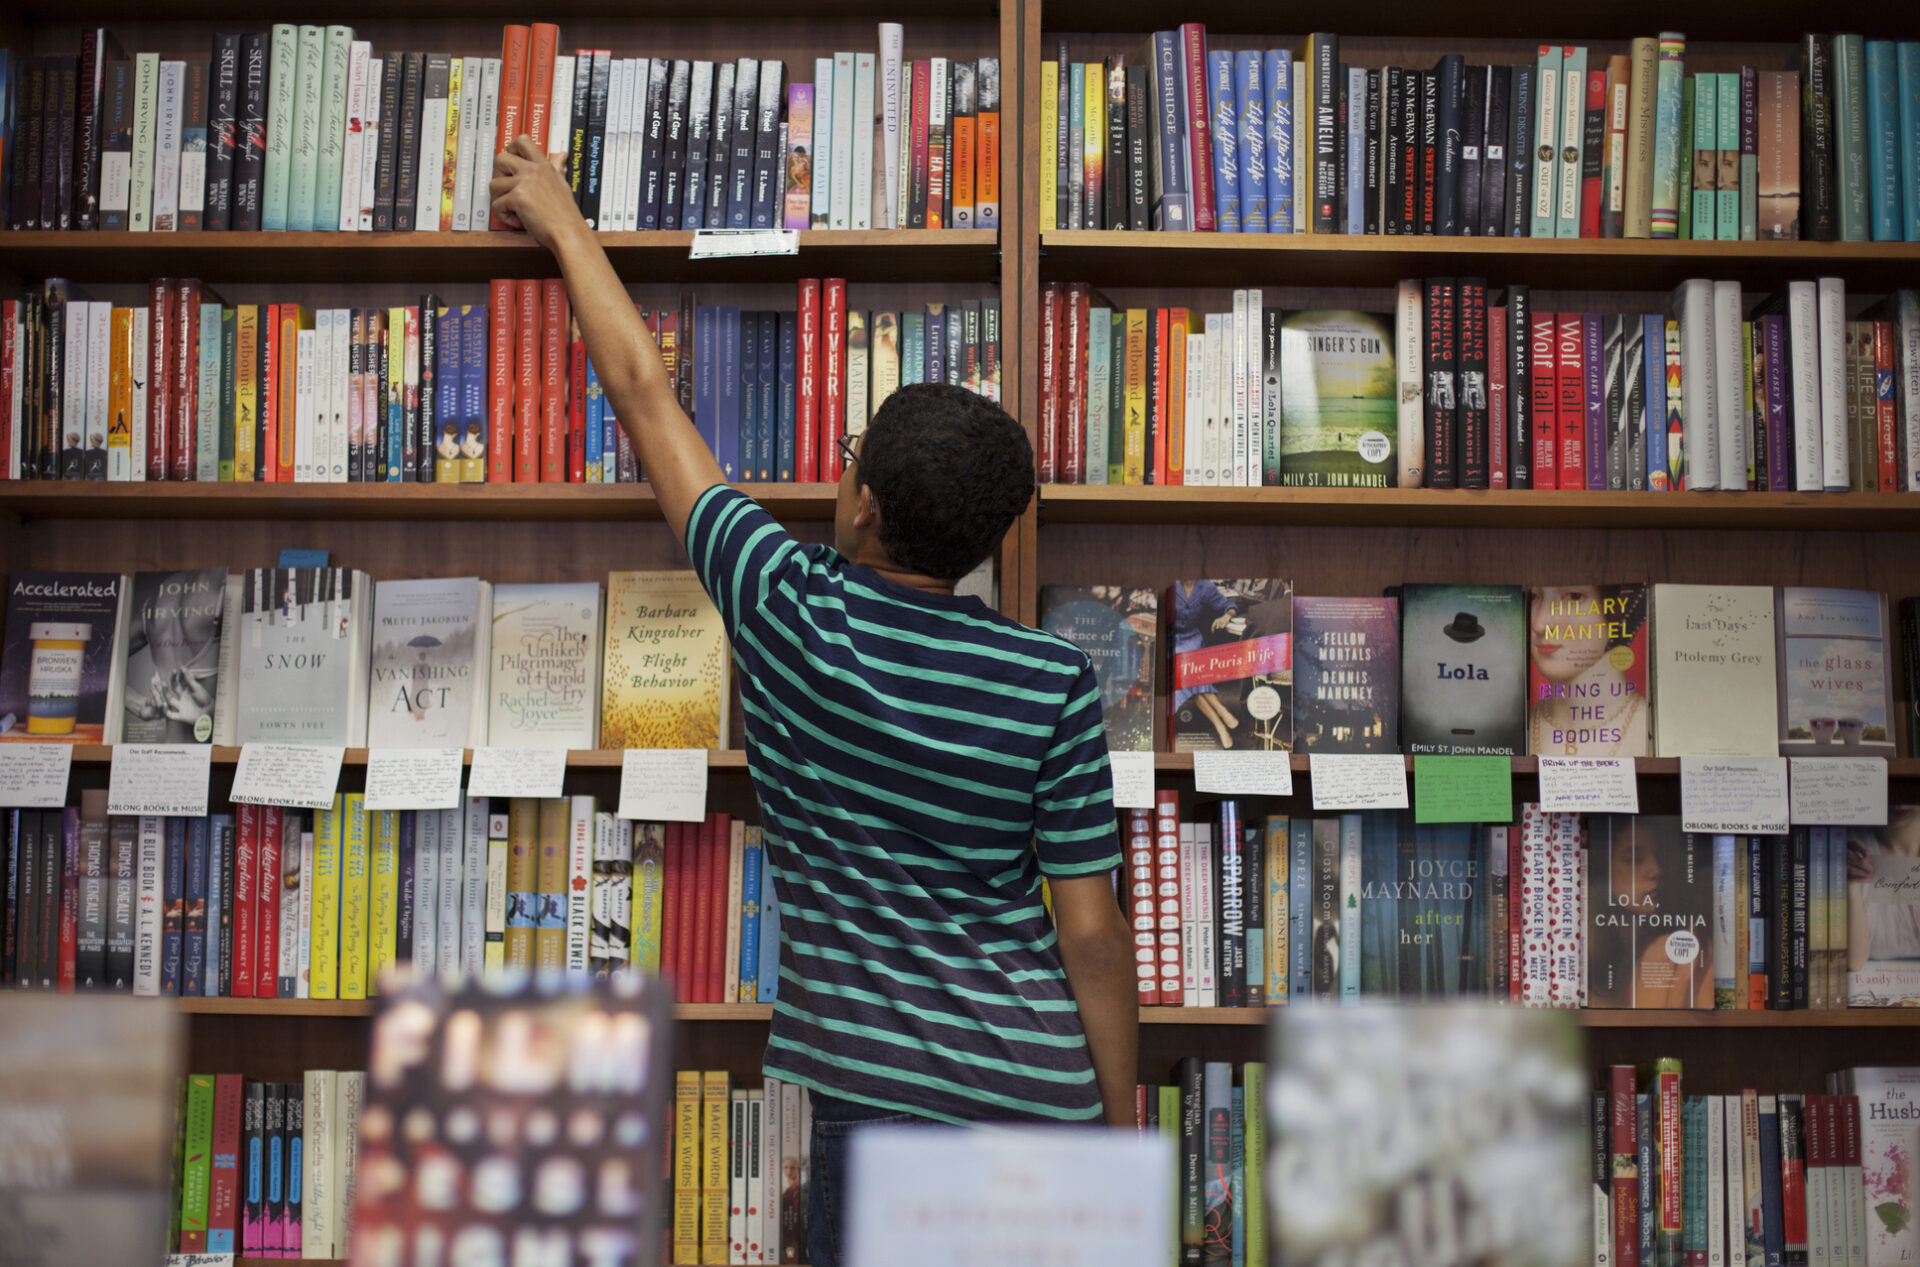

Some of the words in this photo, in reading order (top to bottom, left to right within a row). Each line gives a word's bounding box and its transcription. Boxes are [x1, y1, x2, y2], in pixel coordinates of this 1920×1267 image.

[1191, 31, 1201, 63] DEBBIE
[220, 49, 234, 88] SKULL
[1163, 47, 1174, 71] ICE
[142, 60, 151, 93] JOHN
[1321, 45, 1331, 104] RECONSTRUCTING
[1391, 70, 1399, 85] Ian
[1813, 57, 1825, 98] WHITE
[886, 59, 896, 132] UNINVITED
[1192, 65, 1203, 116] MACOMBER
[1426, 76, 1435, 96] IAN
[1517, 73, 1528, 113] WALKING
[654, 111, 661, 119] of
[1164, 77, 1176, 134] BRIDGE
[1247, 101, 1263, 125] Life
[138, 98, 148, 144] IRVING
[651, 120, 660, 138] Grey
[694, 113, 703, 139] Darker
[763, 111, 772, 132] Freed
[1318, 107, 1333, 153] AMELIA
[1425, 98, 1434, 144] McEWAN
[1815, 103, 1825, 149] FOREST
[573, 129, 583, 150] Eighty
[1246, 127, 1264, 156] After
[1516, 116, 1526, 155] DISASTER
[138, 150, 146, 159] In
[590, 136, 601, 158] Eighty
[1134, 139, 1142, 163] THE
[1445, 129, 1460, 172] Constance
[137, 161, 145, 177] One
[572, 151, 582, 169] Days
[589, 161, 600, 177] Days
[930, 157, 943, 172] HA
[1247, 157, 1264, 180] Life
[1388, 135, 1398, 184] Atonement
[1425, 147, 1434, 183] SWEET
[571, 171, 581, 192] Yellow
[589, 179, 598, 194] Blue
[929, 178, 942, 195] JIN
[1135, 171, 1143, 205] ROAD
[1425, 186, 1433, 221] TOOTH
[497, 285, 507, 324] SIGHT
[1462, 285, 1471, 362] MANKELL
[1475, 287, 1483, 360] HENNING
[1516, 330, 1523, 339] IS
[1360, 338, 1380, 354] GUN
[1533, 321, 1553, 368] Wolf
[240, 315, 254, 397] Mudbound
[263, 342, 271, 372] WHEN
[496, 328, 506, 387] READING
[205, 360, 216, 397] Silver
[852, 353, 862, 430] MARIANA
[1535, 376, 1553, 413] Hall
[262, 402, 270, 432] WOKE
[422, 387, 432, 445] Equilateral
[1268, 395, 1277, 417] Lola
[202, 401, 216, 454] Sparrow
[1268, 420, 1276, 459] Quartet
[1281, 473, 1304, 486] MILY
[1309, 473, 1322, 486] ST.
[1327, 474, 1348, 486] JOHN
[1353, 474, 1388, 488] MANDEL
[14, 581, 117, 598] Accelerated
[158, 581, 210, 598] JOHN
[636, 605, 697, 620] Barbara
[1551, 598, 1629, 617] HILARY
[1074, 616, 1097, 626] THE
[1544, 622, 1634, 641] MANTEL
[554, 626, 578, 642] The
[628, 626, 704, 642] Kingsolver
[1101, 630, 1115, 642] of
[1324, 632, 1366, 646] FELLOW
[265, 654, 327, 670] SNOW
[500, 654, 578, 672] Pilgrimage
[527, 644, 588, 660] Unlikely
[642, 654, 688, 672] Flight
[1180, 661, 1206, 676] The
[1209, 656, 1243, 672] Paris
[1248, 647, 1275, 664] Wife
[1319, 648, 1372, 662] MORTALS
[1674, 650, 1727, 665] Ptolemy
[1731, 654, 1762, 666] Grey
[1800, 658, 1820, 668] the
[1825, 655, 1872, 671] glass
[376, 666, 469, 682] VANISHING
[516, 670, 530, 684] of
[533, 668, 586, 685] Harold
[631, 675, 698, 688] Behavior
[1322, 671, 1368, 684] DENNIS
[1437, 662, 1490, 681] Lola
[562, 686, 586, 702] Fry
[1317, 686, 1374, 700] MAHONEY
[1540, 682, 1600, 700] BRING
[1611, 682, 1637, 697] UP
[1811, 678, 1864, 690] wives
[392, 685, 450, 712] ACT
[500, 692, 548, 708] Rachel
[1569, 706, 1606, 721] THE
[1552, 728, 1622, 744] BODIES
[1411, 743, 1436, 754] EMILY
[1438, 744, 1450, 754] ST.
[1452, 744, 1476, 756] JOHN
[1477, 745, 1516, 756] MANDEL
[108, 804, 142, 812] OBLONG
[181, 804, 206, 812] MUSIC
[1684, 822, 1720, 830] OBLONG
[1722, 822, 1748, 830] BOOKS
[1761, 824, 1786, 832] MUSIC
[87, 840, 101, 876] THOMAS
[144, 840, 156, 862] BLUE
[1297, 832, 1305, 889] TRAPEZE
[237, 838, 253, 902] Advertising
[1408, 860, 1478, 880] JOYCE
[1534, 844, 1544, 883] HEART
[142, 866, 154, 892] BOOK
[1793, 864, 1805, 909] AMERICAN
[86, 879, 99, 923] KENEALLY
[1223, 855, 1242, 936] SPARROW
[1360, 882, 1473, 900] MAYNARD
[1608, 894, 1660, 908] LOLA,
[572, 896, 584, 927] BLACK
[1534, 887, 1544, 924] BROKE
[1415, 910, 1464, 925] after
[1596, 914, 1706, 927] CALIFORNIA
[1794, 911, 1805, 933] RUST
[1400, 929, 1434, 944] her
[1534, 928, 1544, 939] IN
[140, 933, 152, 977] KENNEDY
[570, 932, 583, 970] FLOWER
[1223, 940, 1231, 976] MATTHEWS
[1234, 946, 1242, 968] JASON
[1194, 1073, 1202, 1125] Norwegian
[1596, 1098, 1606, 1122] Black
[682, 1104, 692, 1142] MAGIC
[1596, 1125, 1606, 1149] Swan
[682, 1148, 692, 1187] WORDS
[1597, 1153, 1606, 1180] Green
